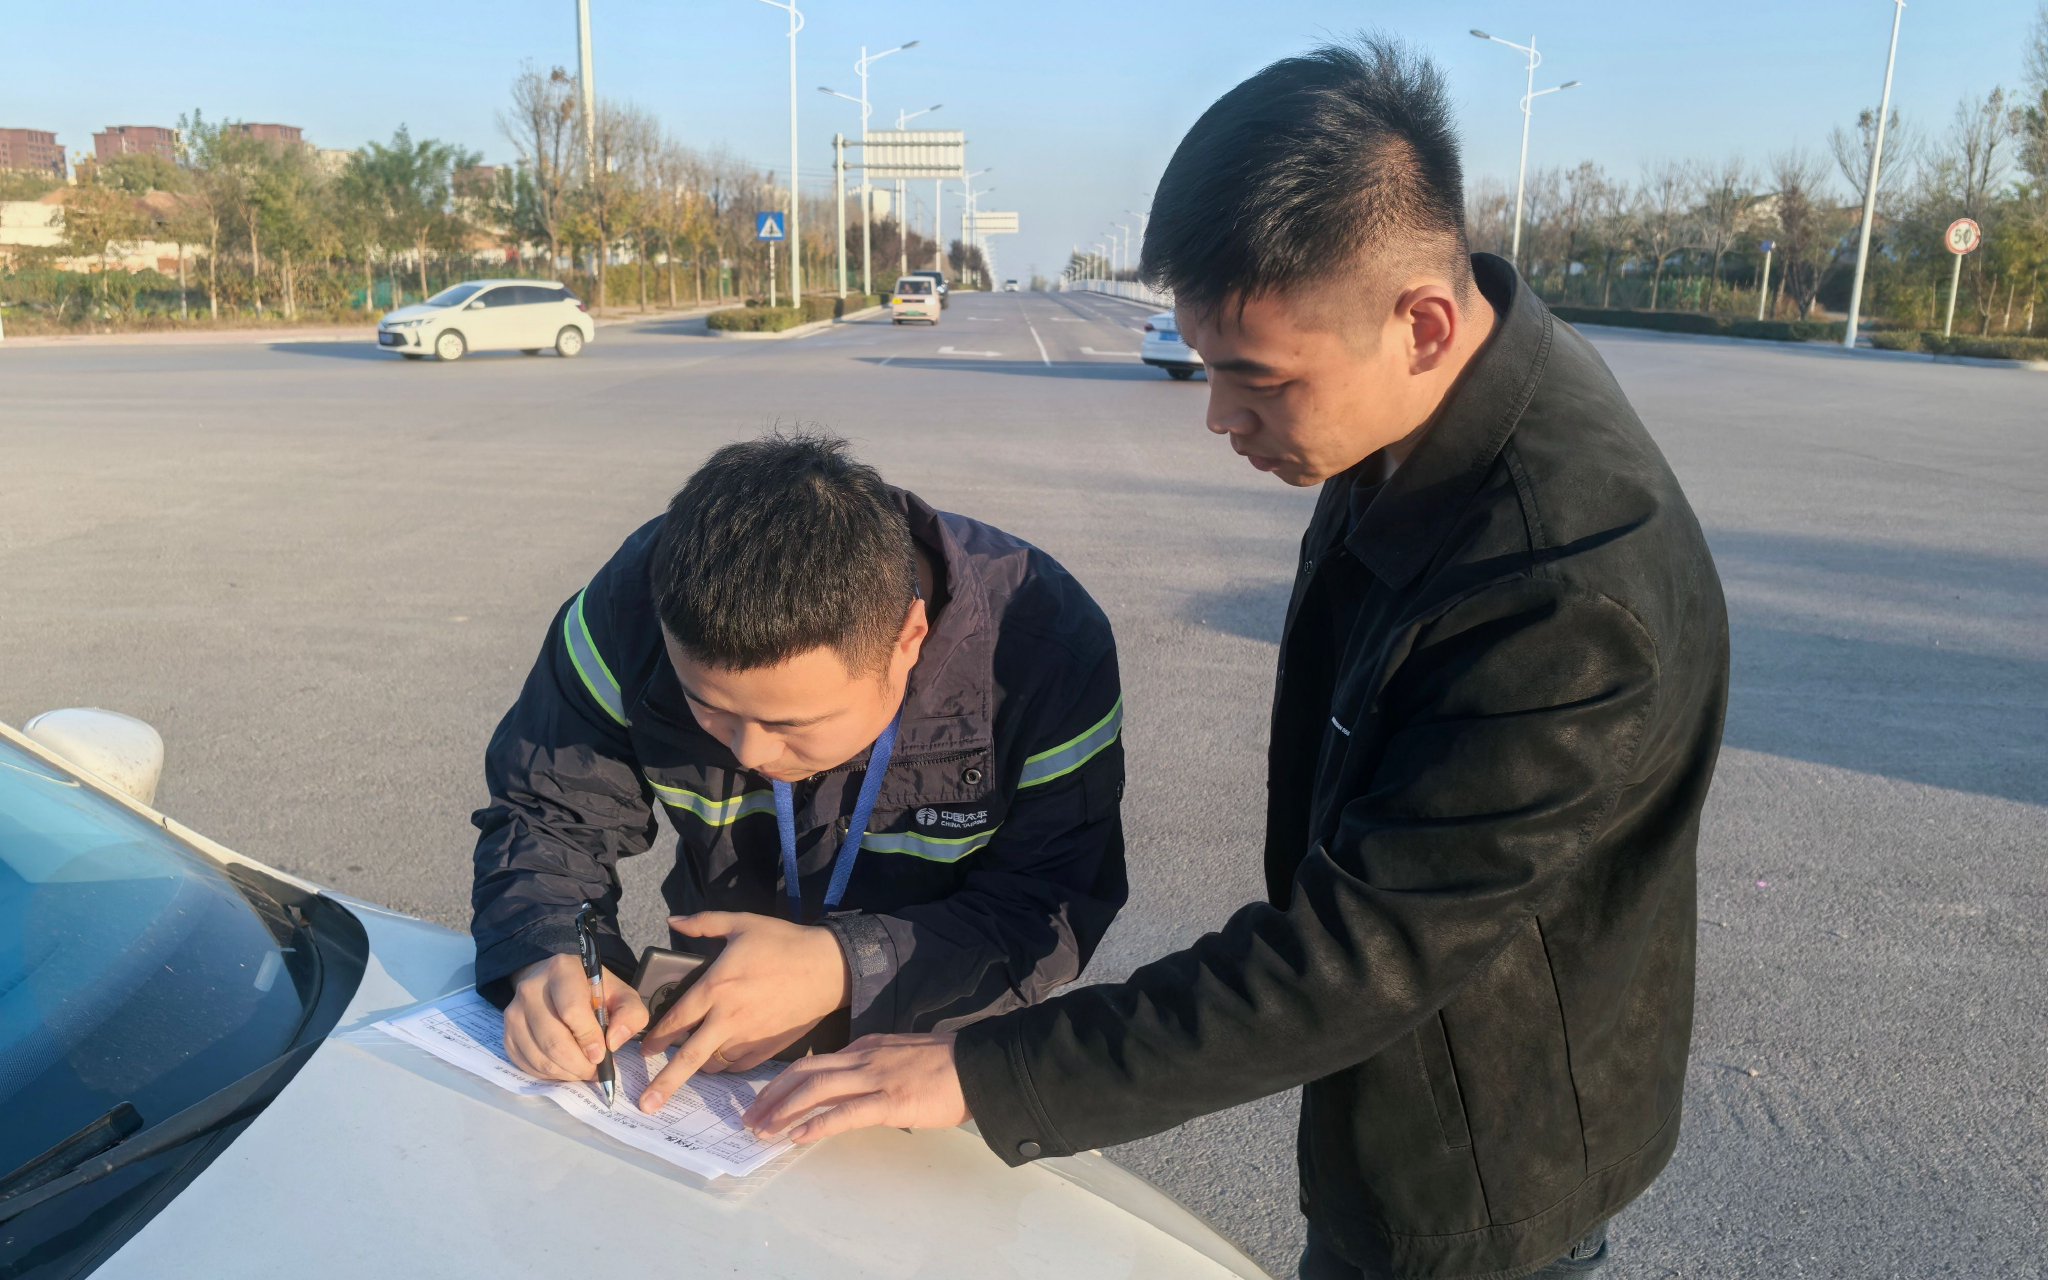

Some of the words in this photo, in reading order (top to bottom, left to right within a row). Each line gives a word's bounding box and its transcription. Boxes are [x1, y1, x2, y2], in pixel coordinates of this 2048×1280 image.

[941, 810, 988, 823] 中国太平
[940, 820, 961, 828] CHINA
